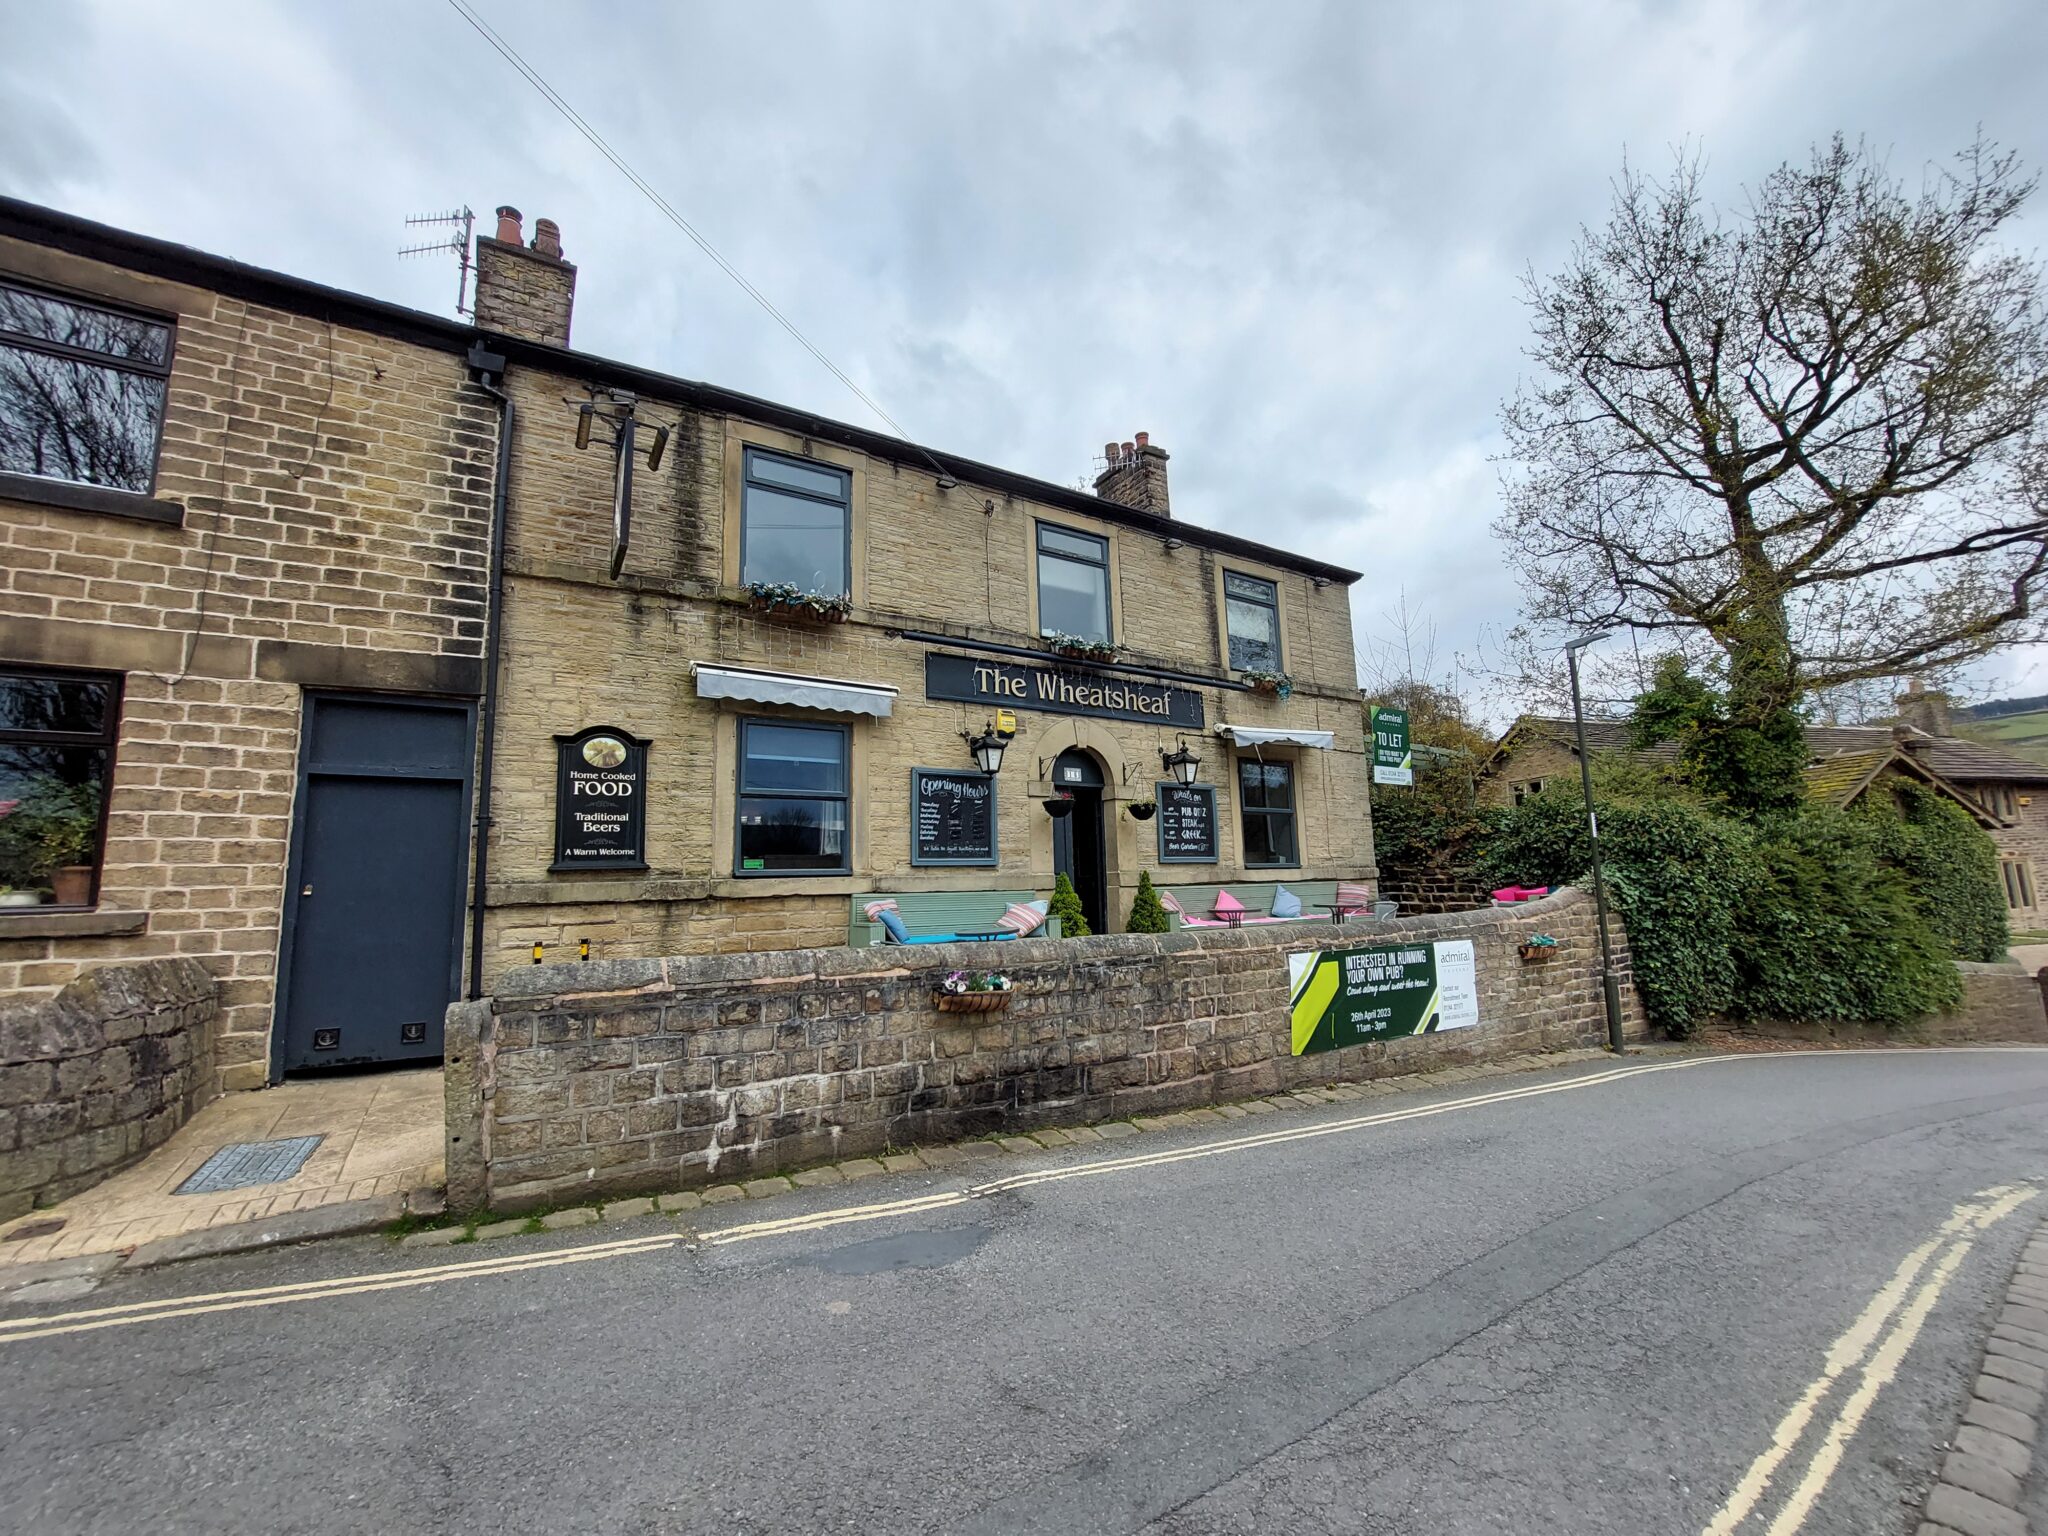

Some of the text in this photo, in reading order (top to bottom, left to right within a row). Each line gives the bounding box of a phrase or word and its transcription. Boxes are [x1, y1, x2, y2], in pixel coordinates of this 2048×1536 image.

[975, 667, 1171, 715] The Wheatsheaf
[1378, 713, 1403, 723] admiral
[1377, 731, 1402, 748] TO LET
[570, 771, 636, 781] Home Cooked
[573, 781, 632, 796] FOOD
[921, 778, 988, 799] Opening Hours
[574, 812, 629, 821] Traditional
[1181, 807, 1207, 817] PUB QUZ
[583, 822, 620, 832] Beers
[1182, 818, 1198, 829] STEAK
[1181, 829, 1201, 840] GREEK
[565, 848, 635, 856] A Warm Welcome
[1345, 950, 1427, 970] INTERESTED IN RUNNING
[1440, 949, 1470, 964] admiral
[1346, 965, 1404, 985] YOUR OWN PUB?
[1346, 986, 1361, 996] Come
[1362, 983, 1378, 997] along
[1379, 980, 1391, 992] and
[1391, 981, 1405, 991] meet
[1404, 977, 1414, 988] the
[1350, 1007, 1392, 1022] 26th April 2023
[1356, 1023, 1371, 1033] 11am
[1374, 1020, 1387, 1031] 3pm
